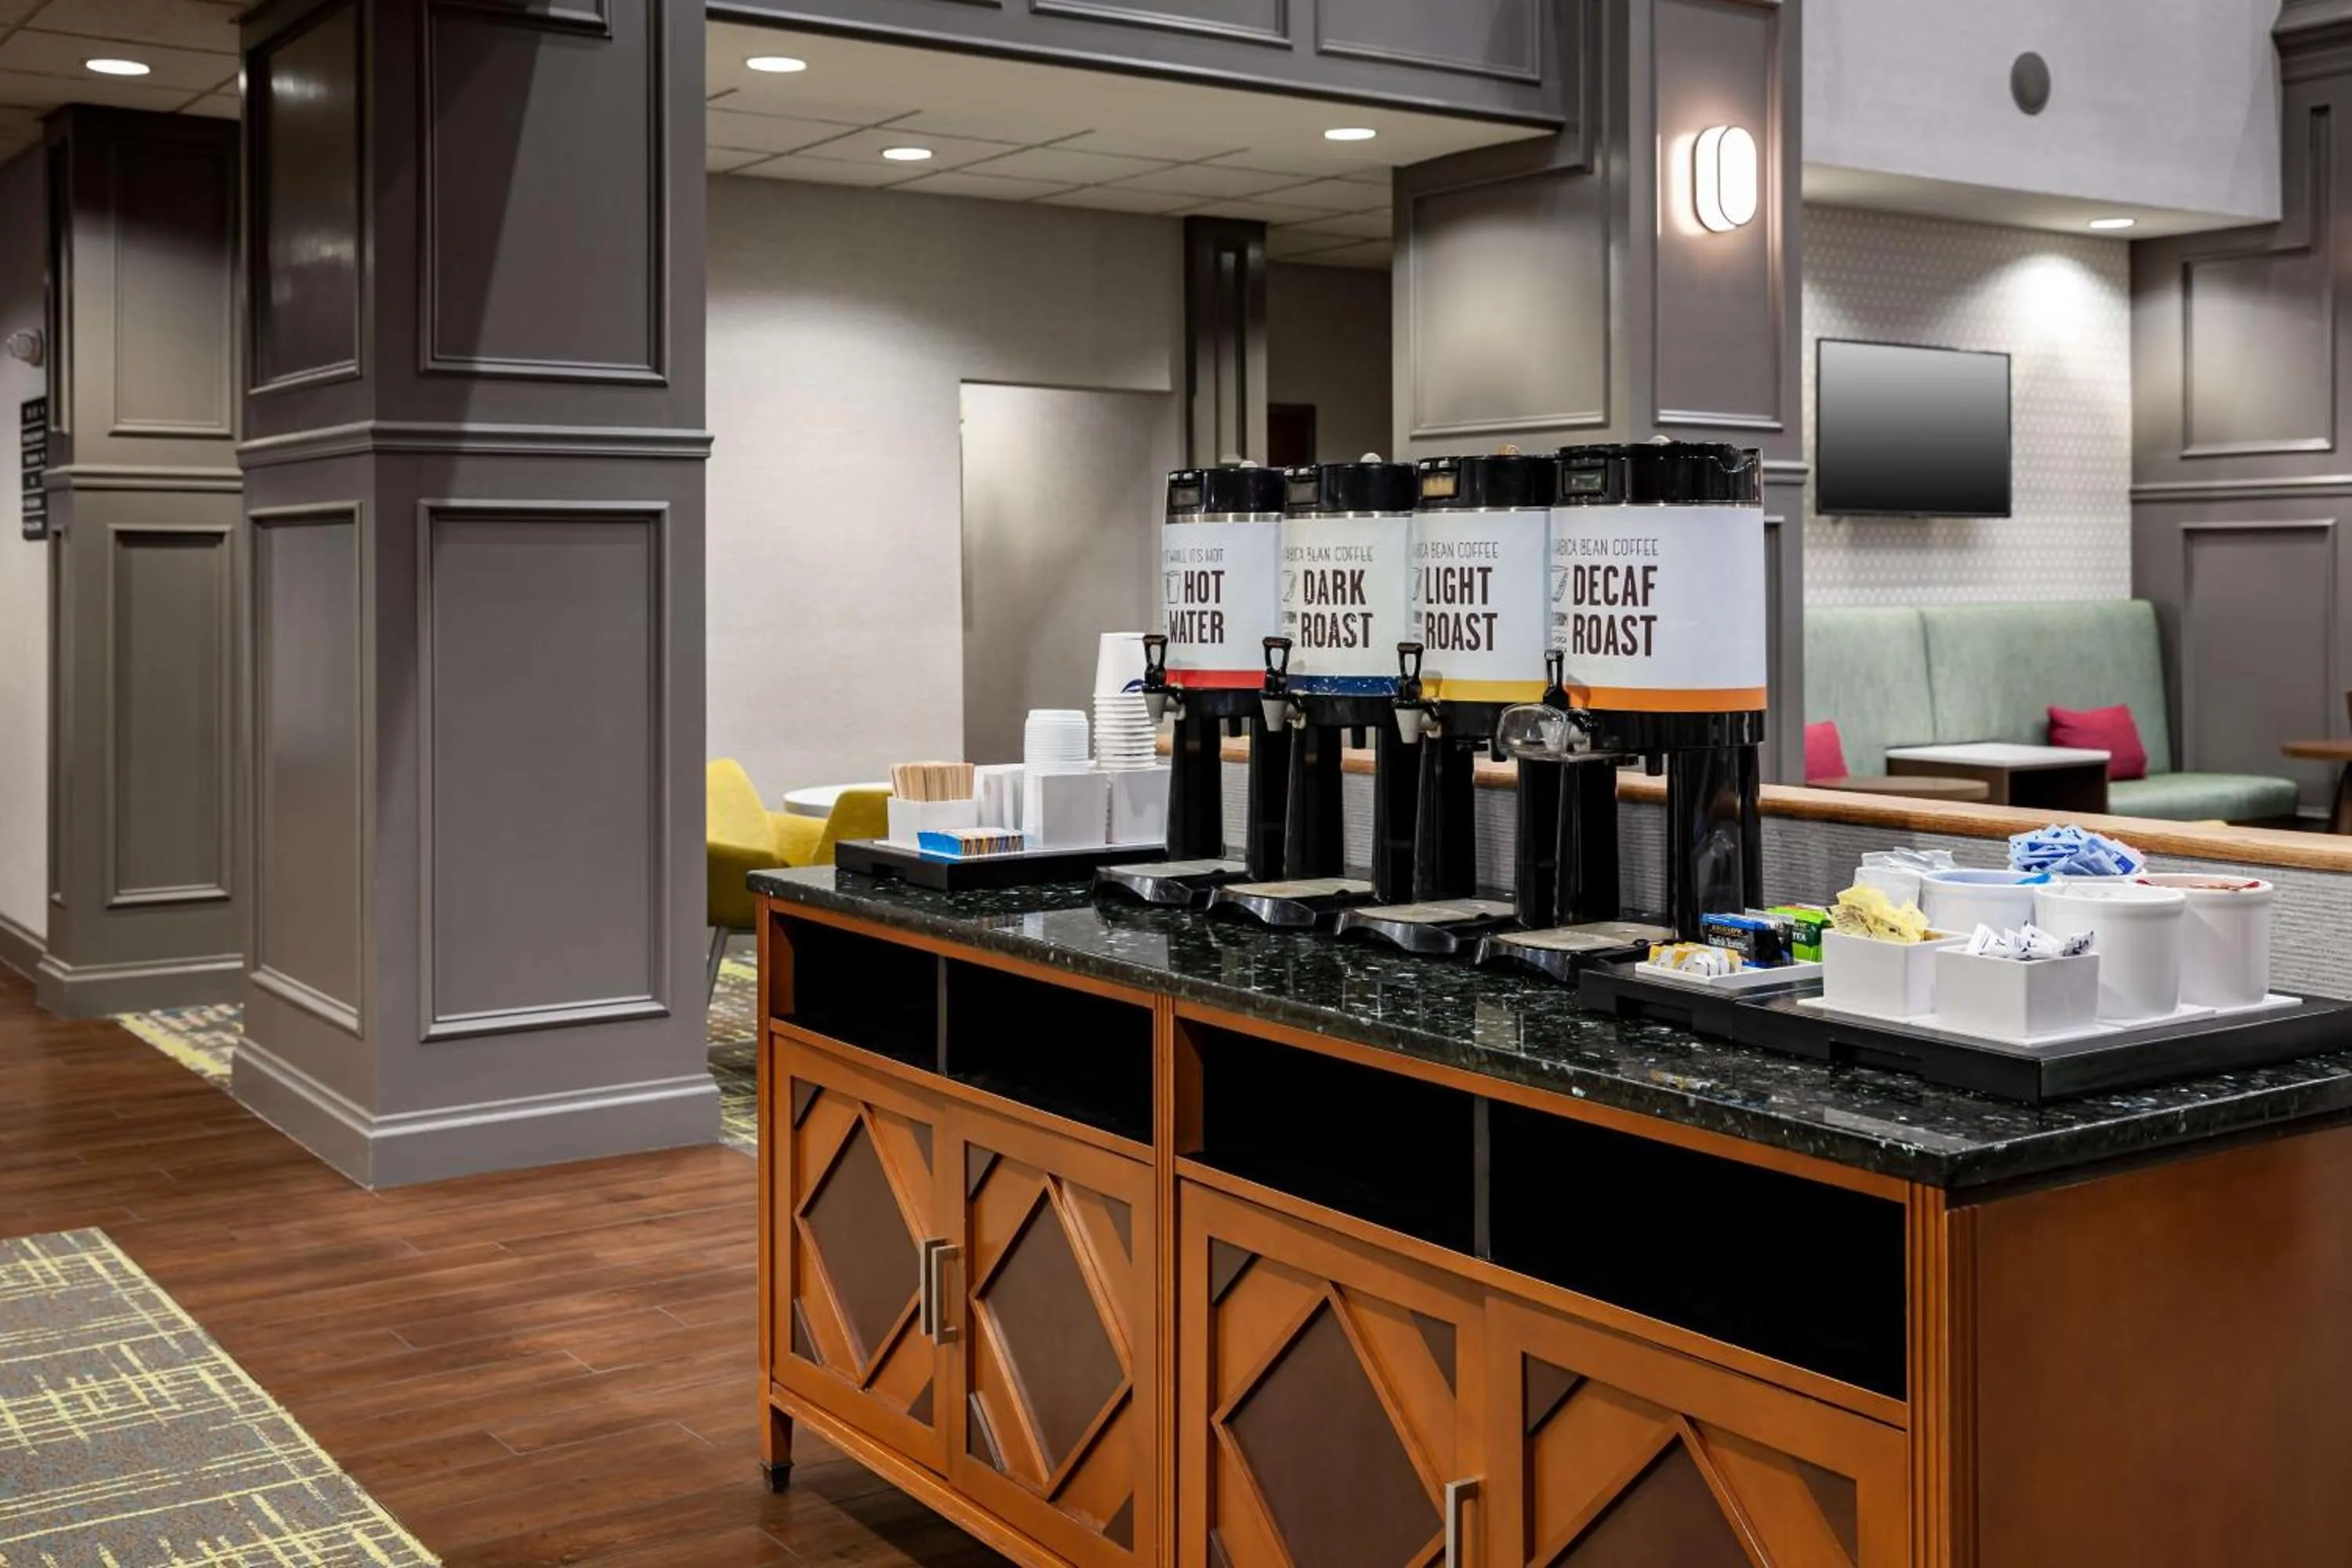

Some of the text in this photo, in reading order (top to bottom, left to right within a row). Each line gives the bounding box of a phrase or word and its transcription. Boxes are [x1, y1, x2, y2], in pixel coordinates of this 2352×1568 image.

[1334, 546, 1374, 562] COFFEE
[1431, 541, 1454, 558] BEAN
[1457, 541, 1499, 559] COFFEE
[1580, 539, 1608, 556] BEAN
[1613, 538, 1660, 556] COFFEE
[1185, 570, 1225, 604] HOT
[1304, 569, 1367, 605] DARK
[1425, 566, 1493, 605] LIGHT
[1573, 564, 1658, 607] DECAF
[1168, 610, 1225, 644] WATER
[1301, 612, 1374, 648] ROAST
[1425, 612, 1498, 652] ROAST
[1572, 613, 1658, 657] ROAST
